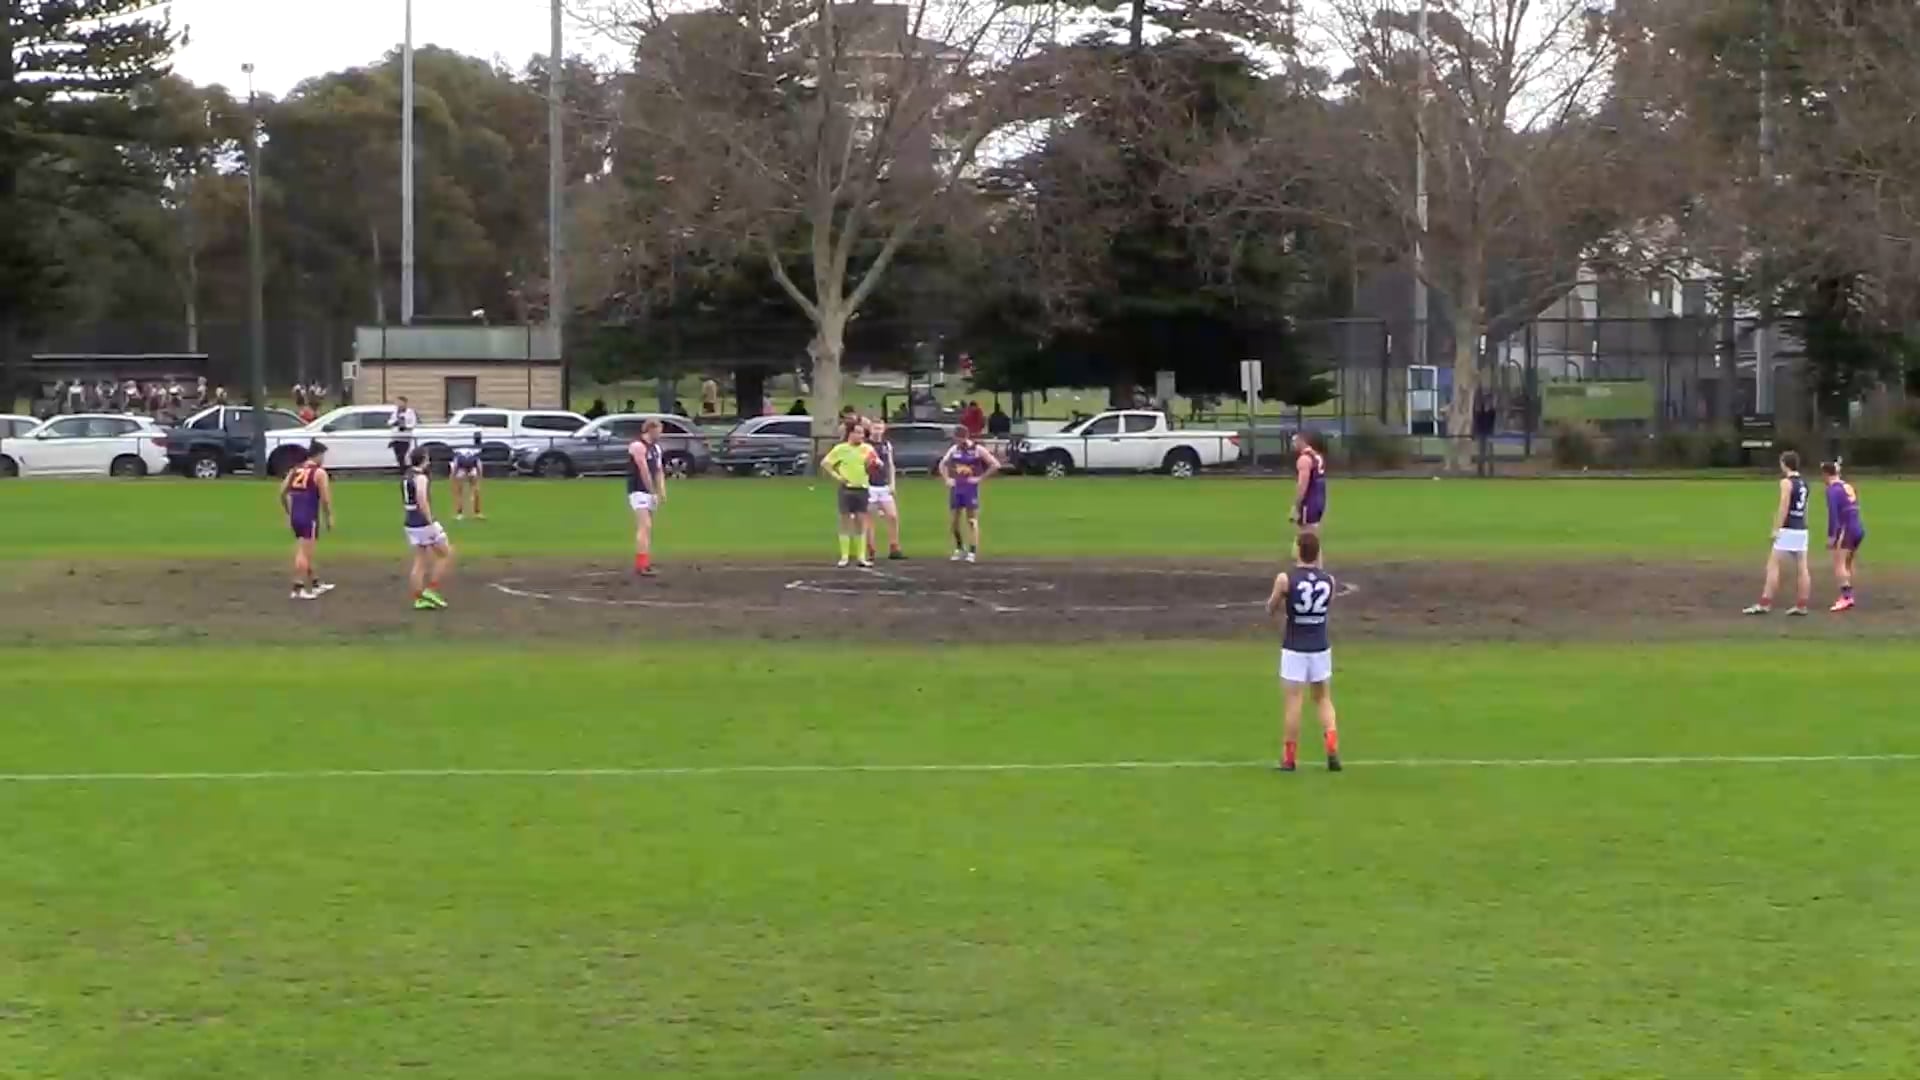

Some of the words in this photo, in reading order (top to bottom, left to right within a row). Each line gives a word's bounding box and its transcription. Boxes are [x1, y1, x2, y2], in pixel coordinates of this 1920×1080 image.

[292, 468, 311, 488] 21
[1796, 486, 1807, 509] 3
[1294, 580, 1331, 613] 32
